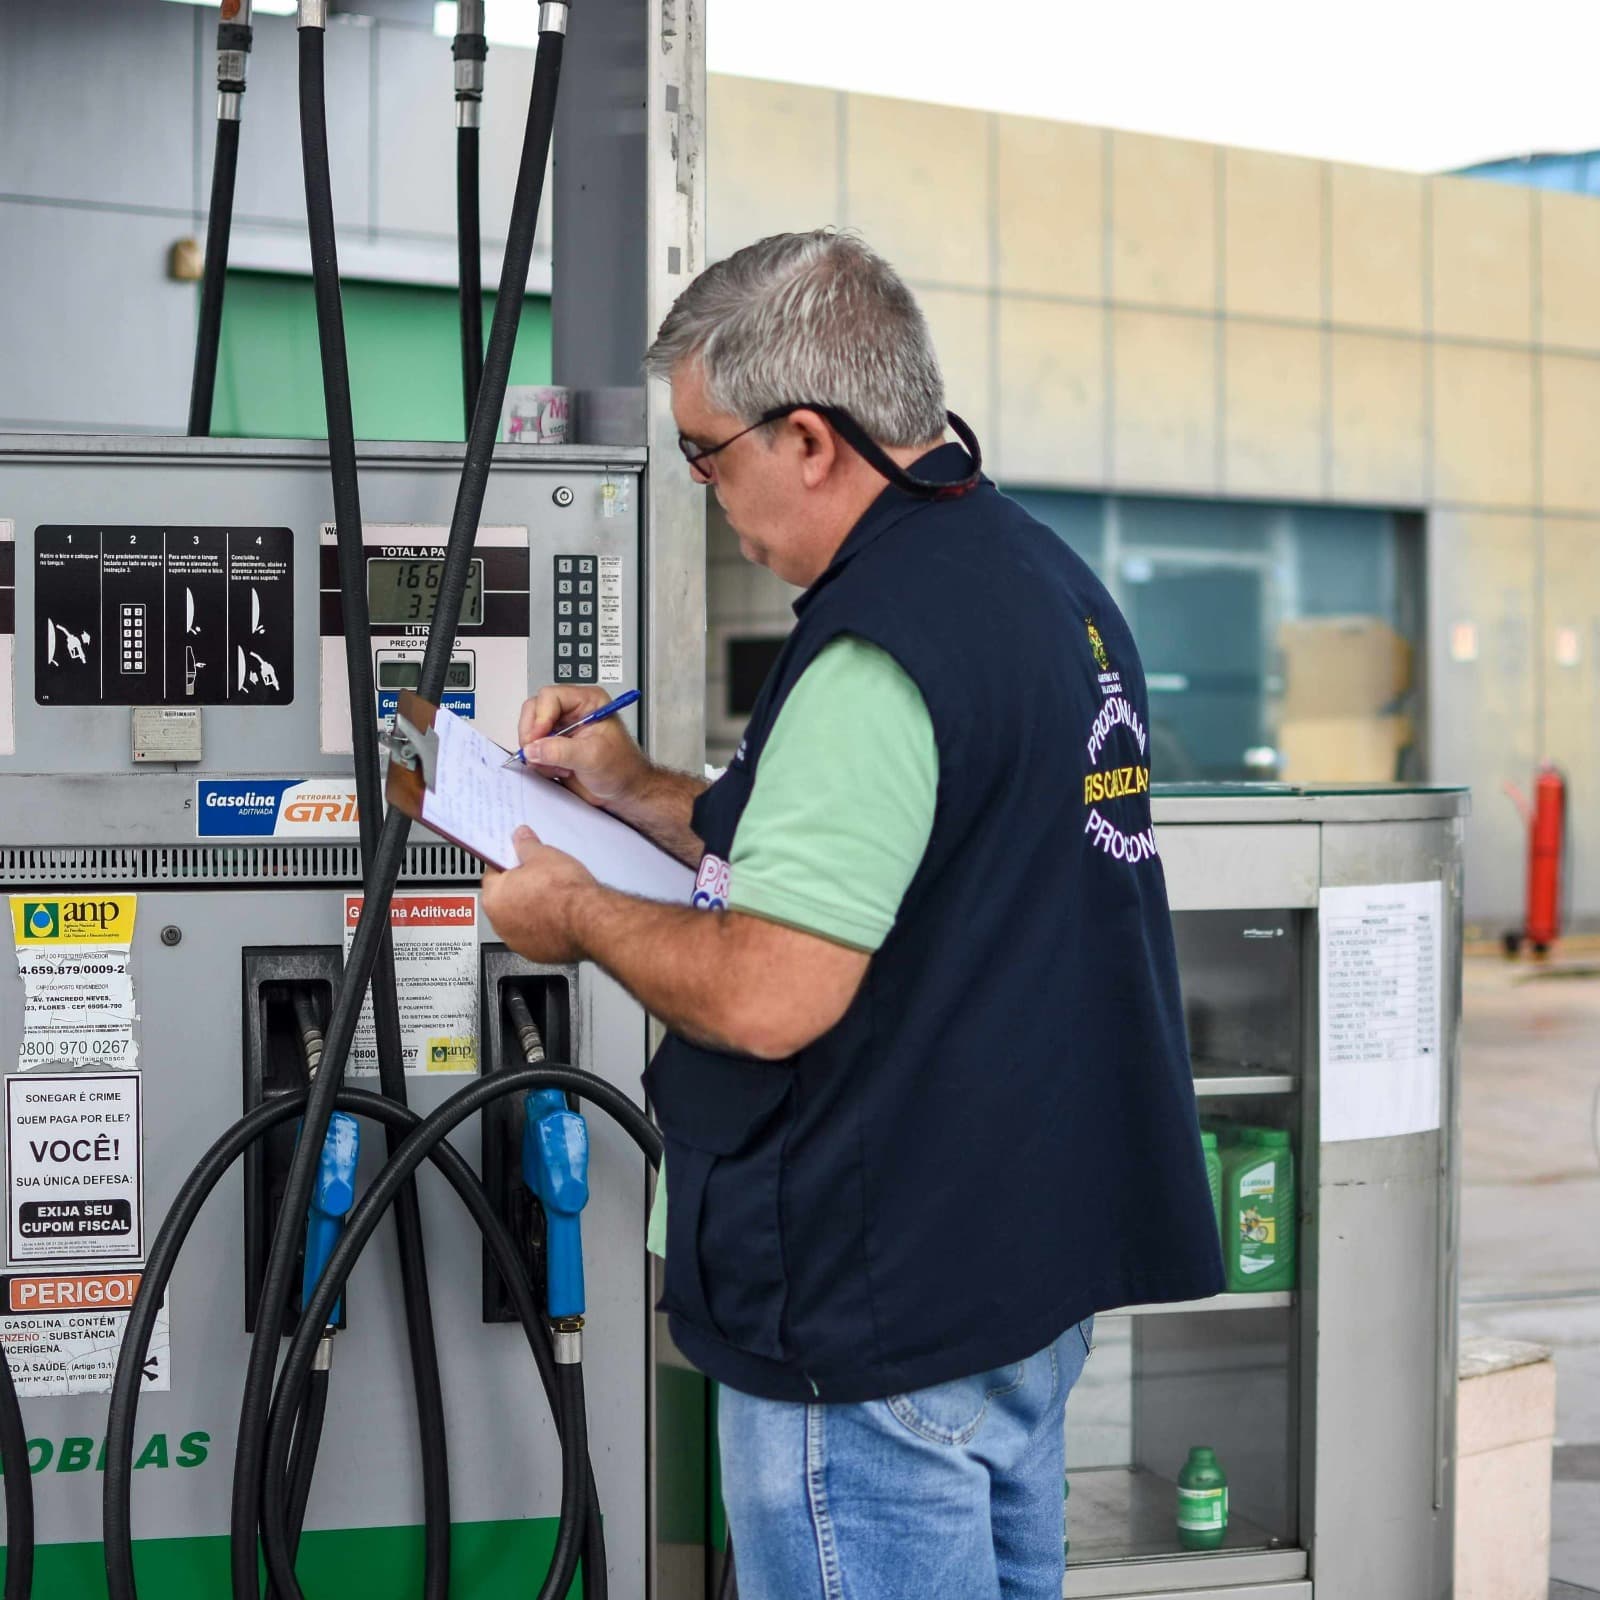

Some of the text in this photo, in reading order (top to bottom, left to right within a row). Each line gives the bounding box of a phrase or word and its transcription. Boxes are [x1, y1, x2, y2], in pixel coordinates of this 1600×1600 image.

[67, 534, 73, 544] 1
[129, 535, 137, 545] 2
[193, 536, 200, 546] 3
[256, 536, 263, 546] 4
[381, 547, 416, 556] TOTAL
[419, 547, 428, 556] A
[405, 626, 430, 635] LITR
[390, 640, 418, 648] PREÇO
[440, 700, 471, 709] asolina
[206, 792, 276, 806] Gasolina
[284, 795, 360, 822] GRI
[64, 902, 120, 930] anp
[411, 906, 472, 918] Aditivada
[19, 965, 124, 975] 4.659.879/0009-2
[60, 1041, 88, 1055] 970
[93, 1040, 129, 1054] 0267
[448, 1046, 471, 1058] anp
[354, 1050, 376, 1058] 0800
[402, 1049, 418, 1058] 267
[26, 1092, 121, 1102] SONEGAR É CRIME
[17, 1114, 130, 1124] QUEM PAGA POR ELE?
[30, 1133, 120, 1162] VOCÊ!
[16, 1174, 133, 1186] SUA ÚNICA DEFESA:
[38, 1205, 112, 1218] EXIJA SEU
[22, 1220, 129, 1233] CUPOM FISCAL
[20, 1280, 133, 1304] PERIGO!
[4, 1316, 116, 1330] GASOLINA CONTÉM
[0, 1330, 116, 1342] ENZENO SUBSTÂNCIA
[5, 1344, 62, 1354] NCERÍGENA.
[72, 1362, 96, 1370] (Artigo
